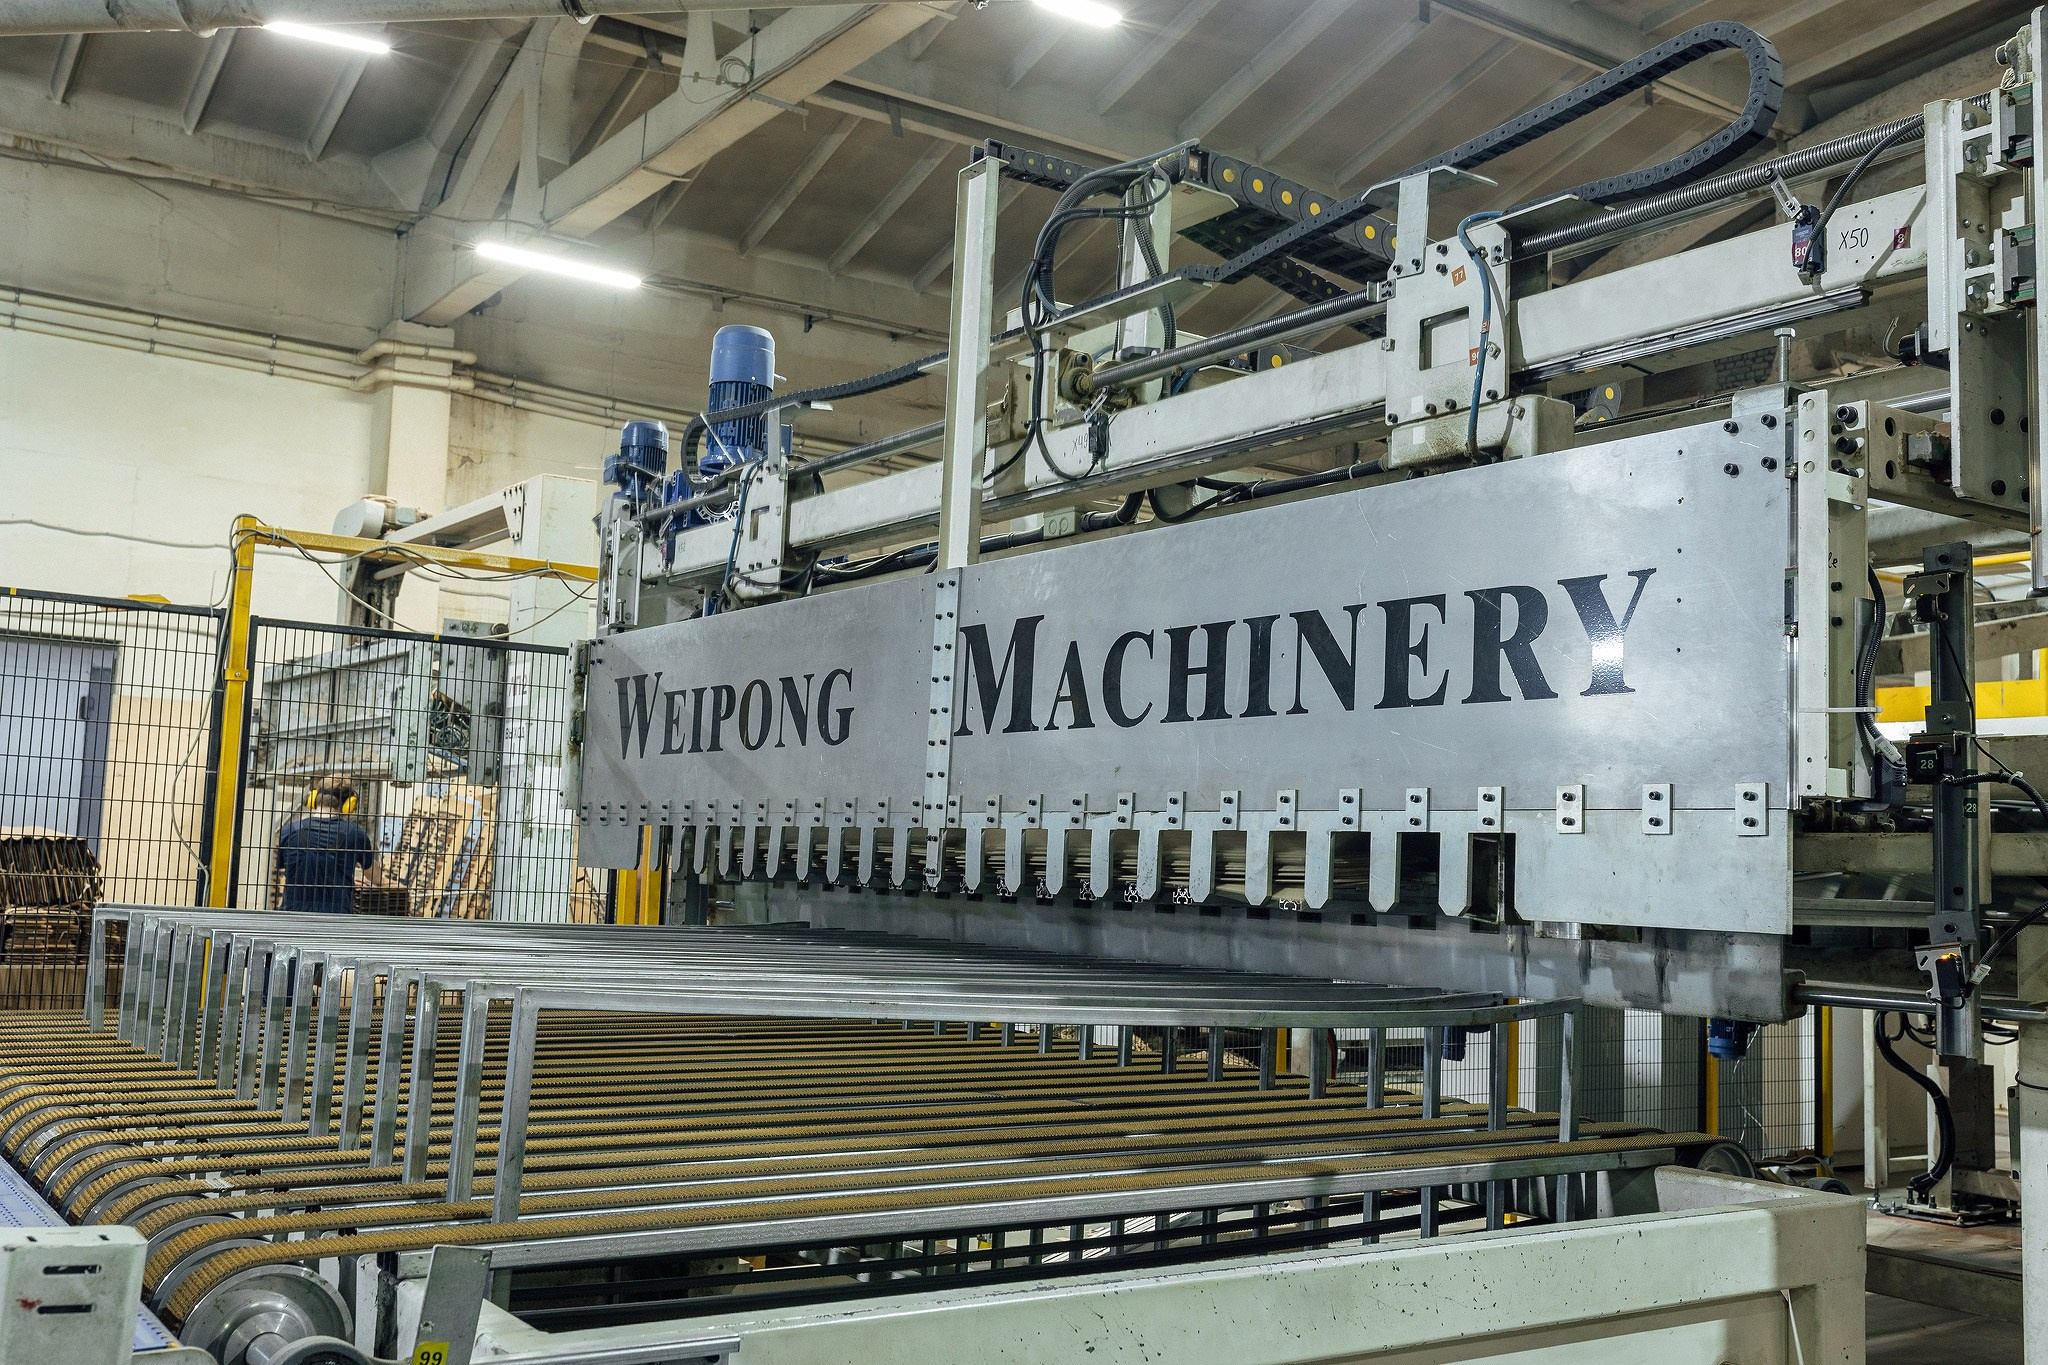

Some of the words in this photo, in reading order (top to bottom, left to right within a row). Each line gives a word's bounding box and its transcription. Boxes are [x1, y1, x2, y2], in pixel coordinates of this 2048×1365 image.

[1839, 227, 1869, 250] X50
[1455, 271, 1464, 281] 77
[615, 668, 855, 760] WEIPONG
[953, 567, 1657, 737] MACHINERY
[1920, 759, 1934, 769] 28
[1966, 802, 1977, 813] 28
[420, 1351, 442, 1365] 99
